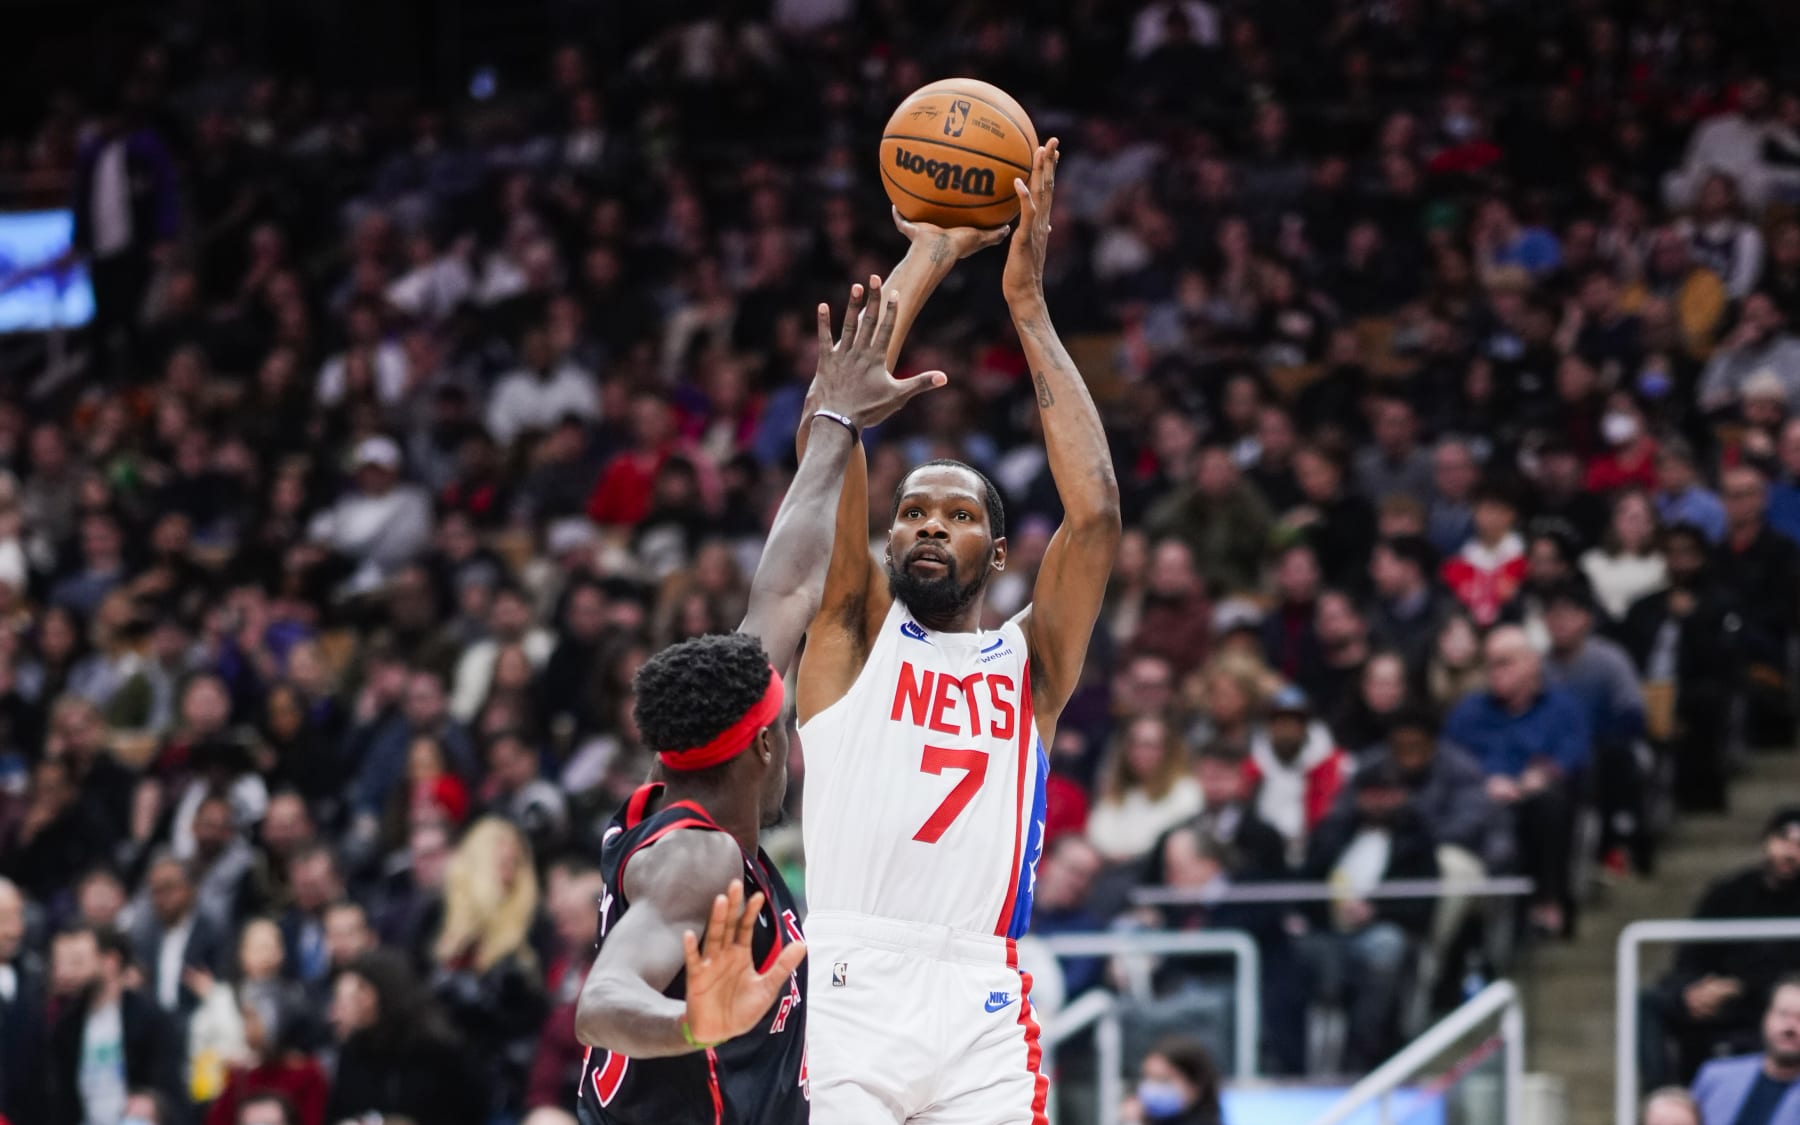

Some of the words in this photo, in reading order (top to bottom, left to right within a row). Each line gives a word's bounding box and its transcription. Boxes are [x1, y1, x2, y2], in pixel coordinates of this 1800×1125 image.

[895, 147, 995, 196] Wilson
[907, 620, 929, 640] NIKE
[980, 648, 1012, 664] Webull
[891, 661, 1014, 741] NETS
[912, 744, 989, 844] 7
[990, 991, 1010, 1004] NIKE
